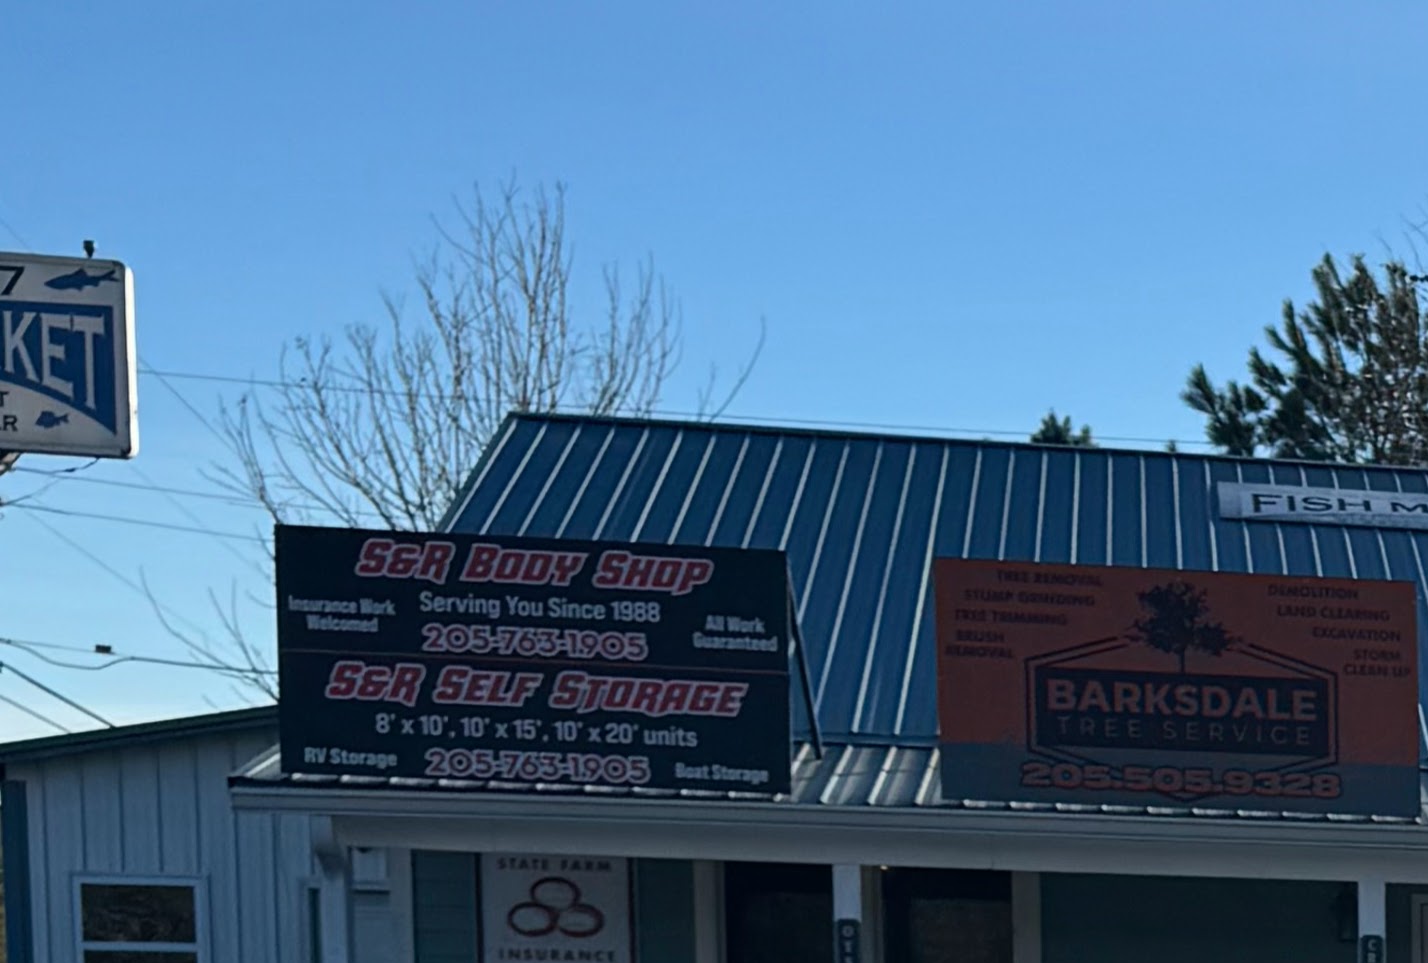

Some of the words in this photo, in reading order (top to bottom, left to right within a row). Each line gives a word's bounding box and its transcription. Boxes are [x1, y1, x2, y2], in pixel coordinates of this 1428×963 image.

[1251, 494, 1373, 513] FISH
[355, 538, 456, 584] S&R
[460, 543, 589, 586] BODY
[592, 550, 715, 595] SHOP
[997, 570, 1028, 583] TREE
[1031, 571, 1103, 587] REMOVAL
[964, 589, 1014, 604] STUMP
[1018, 590, 1096, 607] GRINDING
[1268, 584, 1359, 601] DEMOLITION
[288, 595, 358, 615] Insurance
[360, 598, 396, 616] Work
[419, 591, 500, 619] Serving
[505, 595, 543, 618] You
[547, 599, 605, 621] Since
[610, 601, 660, 623] 1988
[1278, 605, 1317, 619] LAND
[1321, 605, 1390, 622] CLEARING
[306, 614, 379, 633] Welcomed
[725, 615, 766, 634] Work
[955, 608, 988, 622] TREE
[991, 611, 1068, 626] TRIMMING
[420, 622, 649, 661] 205-763-1905
[692, 632, 778, 652] Guaranteed
[956, 629, 1004, 643] BRUSH
[1312, 626, 1401, 642] EXCAVATION
[945, 644, 1014, 659] REMOVAL
[1353, 648, 1402, 662] STORM
[1343, 663, 1389, 677] CLEAN
[1392, 665, 1410, 679] UP
[325, 659, 426, 708] S&R
[432, 664, 544, 708] SELF
[548, 669, 749, 718] STORAGE
[1046, 679, 1319, 721] BARKSDALE
[643, 725, 698, 748] units
[1059, 715, 1141, 739] TREE
[1164, 720, 1310, 747] SERVICE
[303, 746, 325, 765] RV
[330, 747, 398, 771] Storage
[424, 747, 651, 784] 205-763-1905
[675, 762, 707, 782] Boat
[711, 764, 769, 785] Storage
[1020, 762, 1342, 799] 205.505.9328
[498, 858, 549, 870] STATE
[560, 860, 611, 872] FARM
[498, 948, 614, 962] INSURANCE
